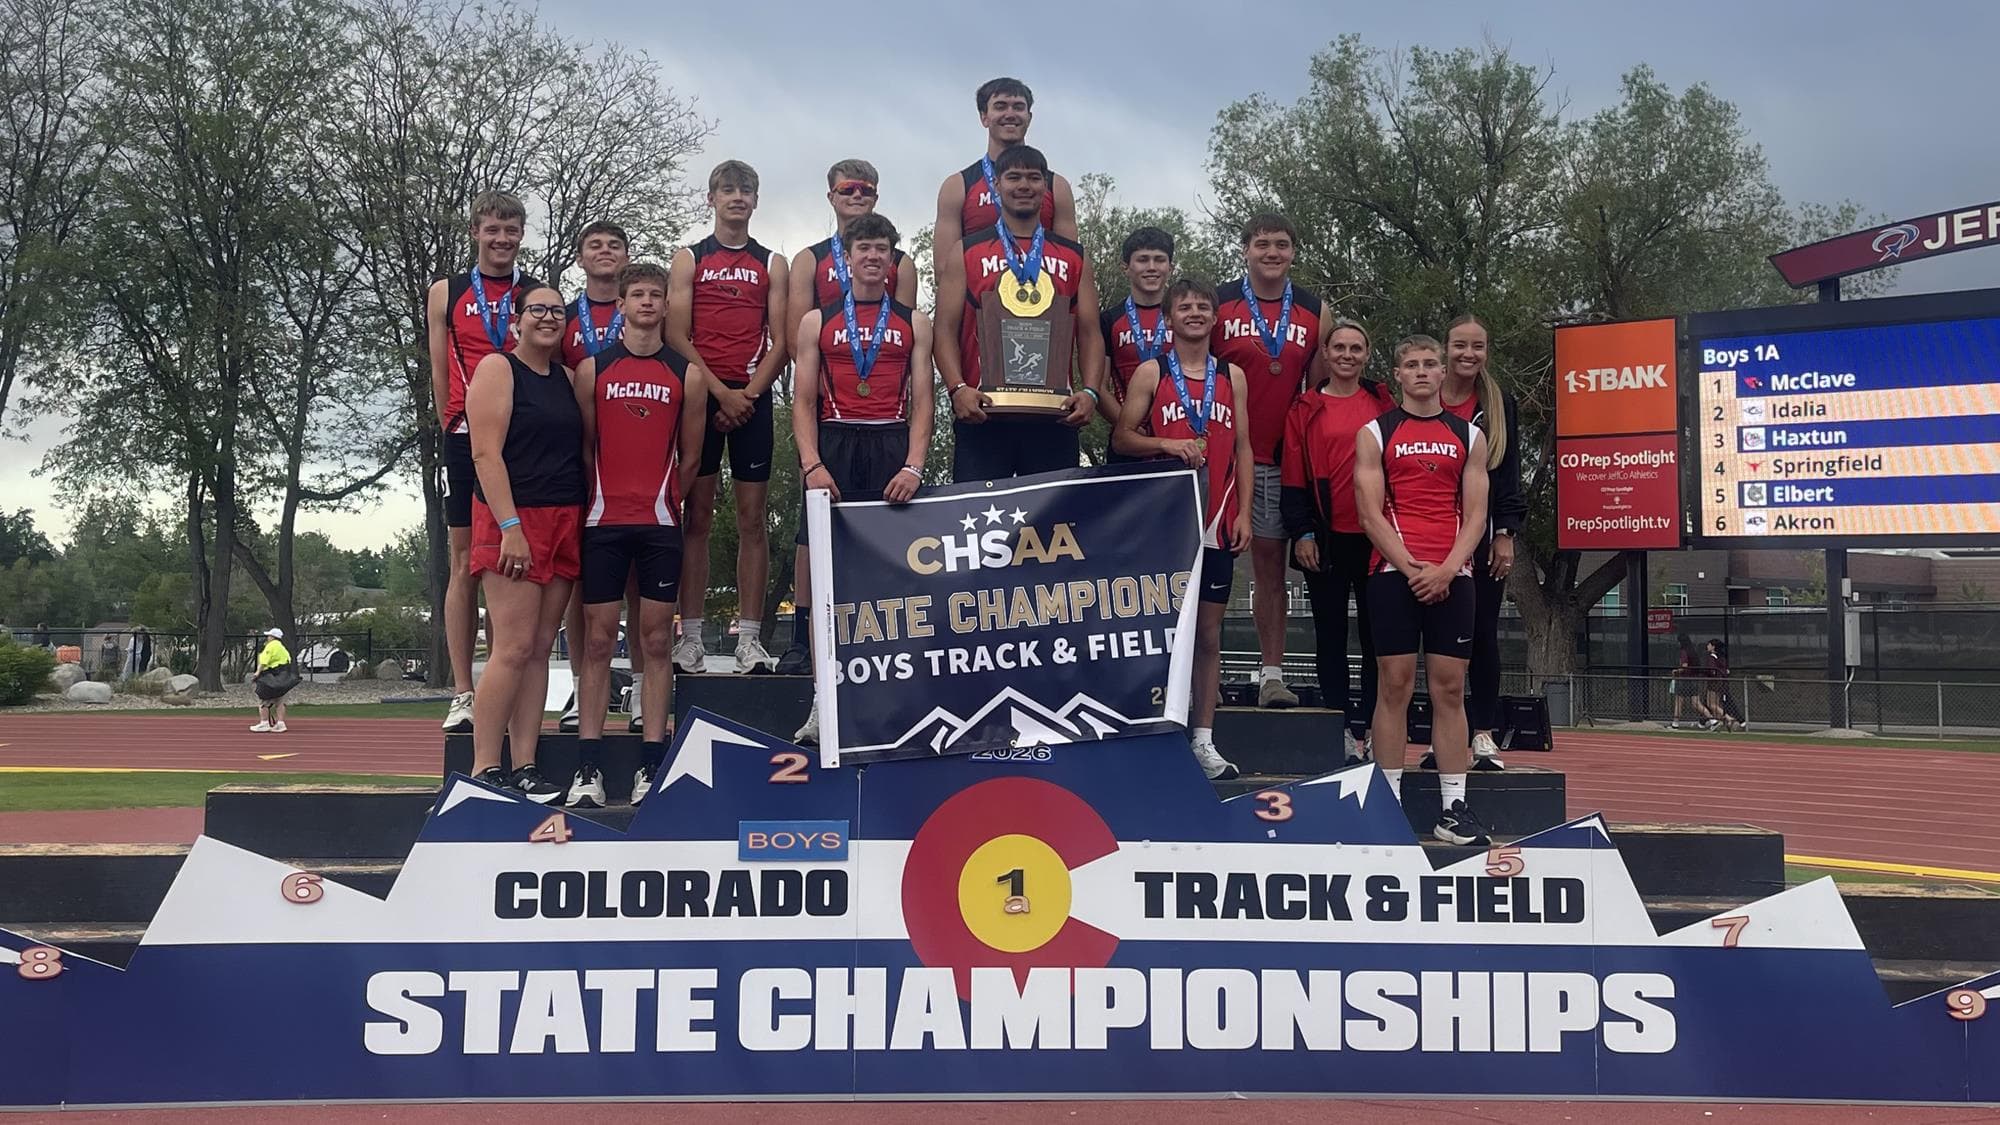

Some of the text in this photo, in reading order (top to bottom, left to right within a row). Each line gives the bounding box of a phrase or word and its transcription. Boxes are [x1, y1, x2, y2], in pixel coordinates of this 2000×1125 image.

[700, 267, 759, 285] McCLAVE
[981, 255, 1068, 282] McVE
[1703, 344, 1780, 367] Boys 1A
[1564, 364, 1668, 393] 1STBANK
[1713, 371, 1856, 393] 1 McClave
[605, 382, 671, 404] McCLAVE
[1713, 401, 1827, 421] 2 Idalia
[1394, 440, 1458, 459] McCLAVE
[1713, 430, 1847, 448] 3 Haxtun
[1560, 449, 1675, 469] CO Prep Spotlight
[1714, 454, 1882, 478] 4 Springfield
[1576, 472, 1588, 481] We
[1629, 470, 1658, 480] Athletics
[1715, 485, 1834, 503] 5 Elbert
[1567, 515, 1670, 533] PrepSpotlight.tv
[1715, 515, 1835, 531] 6 Akron
[906, 522, 1085, 575] CHSAA
[834, 594, 935, 645] TATE
[924, 639, 1042, 677] TRACK
[1052, 637, 1077, 663] &
[767, 751, 810, 784] 2
[1253, 789, 1295, 822] 3
[529, 812, 573, 844] 4
[747, 831, 842, 850] BOYS
[1485, 845, 1525, 877] 5
[280, 871, 324, 904] 6
[494, 869, 1585, 924] COLORADO TRACK & FIELD
[996, 868, 1026, 900] 1
[1003, 895, 1031, 914] a
[1711, 914, 1750, 948] 7
[17, 945, 64, 980] 8
[363, 966, 1677, 1056] STATE CHAMPIONSHIPS
[1945, 987, 1987, 1021] 9
